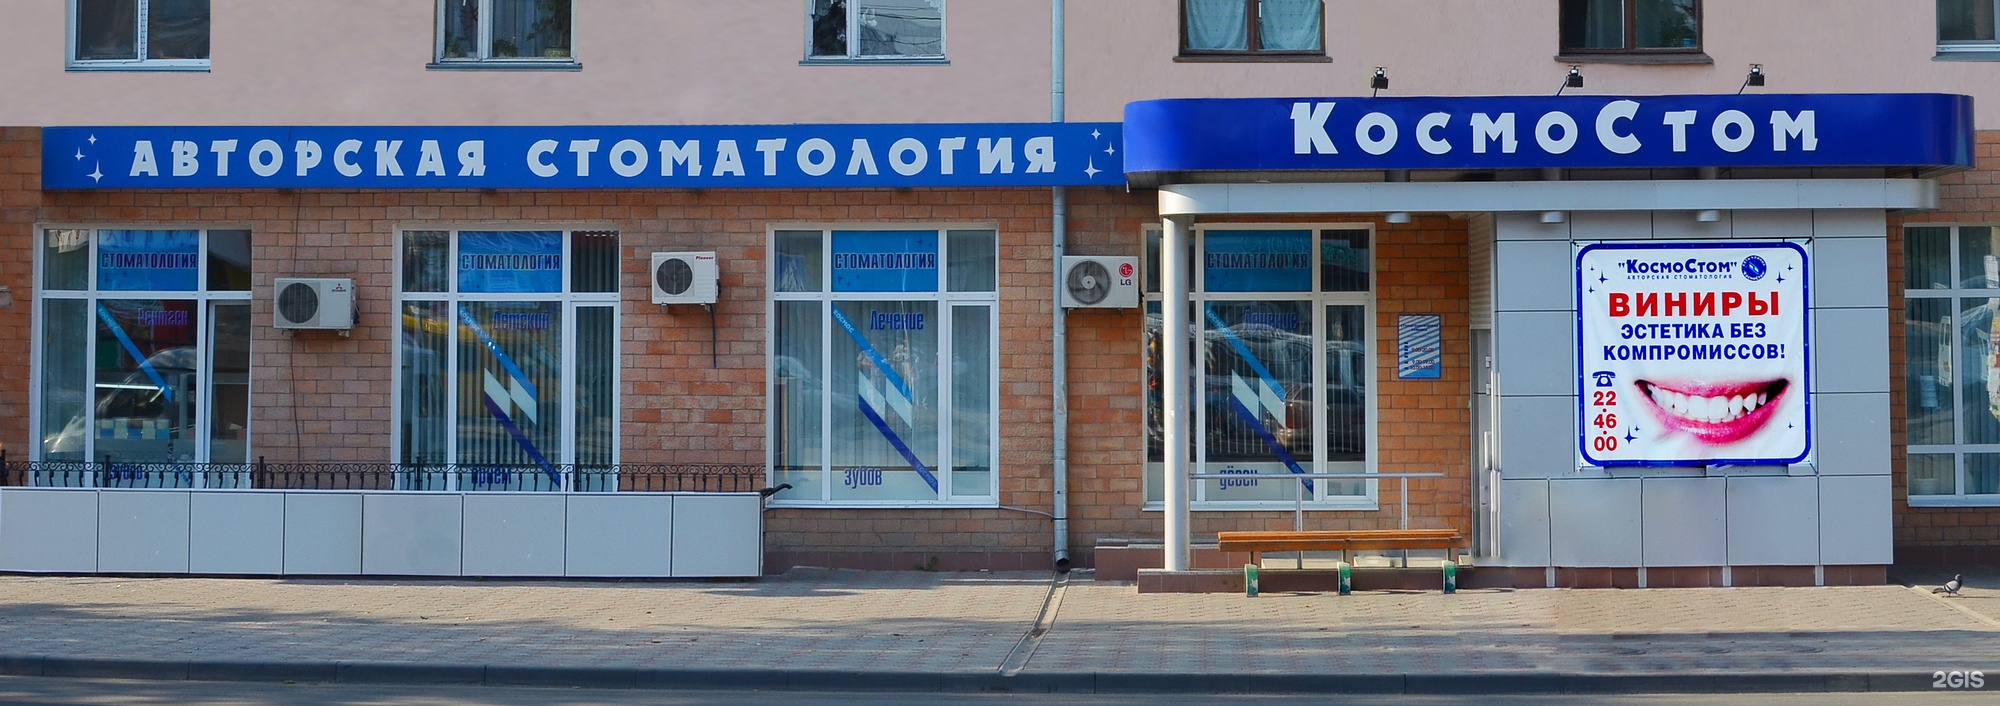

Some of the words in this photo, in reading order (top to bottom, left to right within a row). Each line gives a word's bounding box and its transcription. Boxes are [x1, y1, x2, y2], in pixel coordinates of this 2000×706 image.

[1291, 100, 1817, 154] КосмоСтом
[130, 140, 485, 176] АВТОРСКАЯ
[527, 137, 1056, 176] СТОМАТОЛОГИЯ
[101, 252, 197, 269] СТОМАТОЛОГИЯ
[461, 253, 560, 270] СТОМАТОЛОГИЯ
[834, 253, 935, 269] СТОМАТОЛОГИЯ
[1207, 253, 1308, 269] СТОМАТОЛОГИЯ
[1609, 291, 1780, 317] ВИНИРЫ
[492, 309, 549, 330] Детский
[833, 309, 854, 333] КОСМОС
[870, 310, 924, 331] Лечение
[1244, 309, 1298, 331] Лечение
[1621, 323, 1724, 339] ЭСТЕТИКА
[1730, 323, 1766, 338] БЕЗ
[1603, 344, 1785, 361] КОМПРОМИССОВ!
[1593, 390, 1617, 406] 22
[1593, 413, 1617, 429] 46
[1594, 435, 1618, 452] 00
[844, 465, 882, 489] зубов
[1290, 463, 1313, 487] КОСОС
